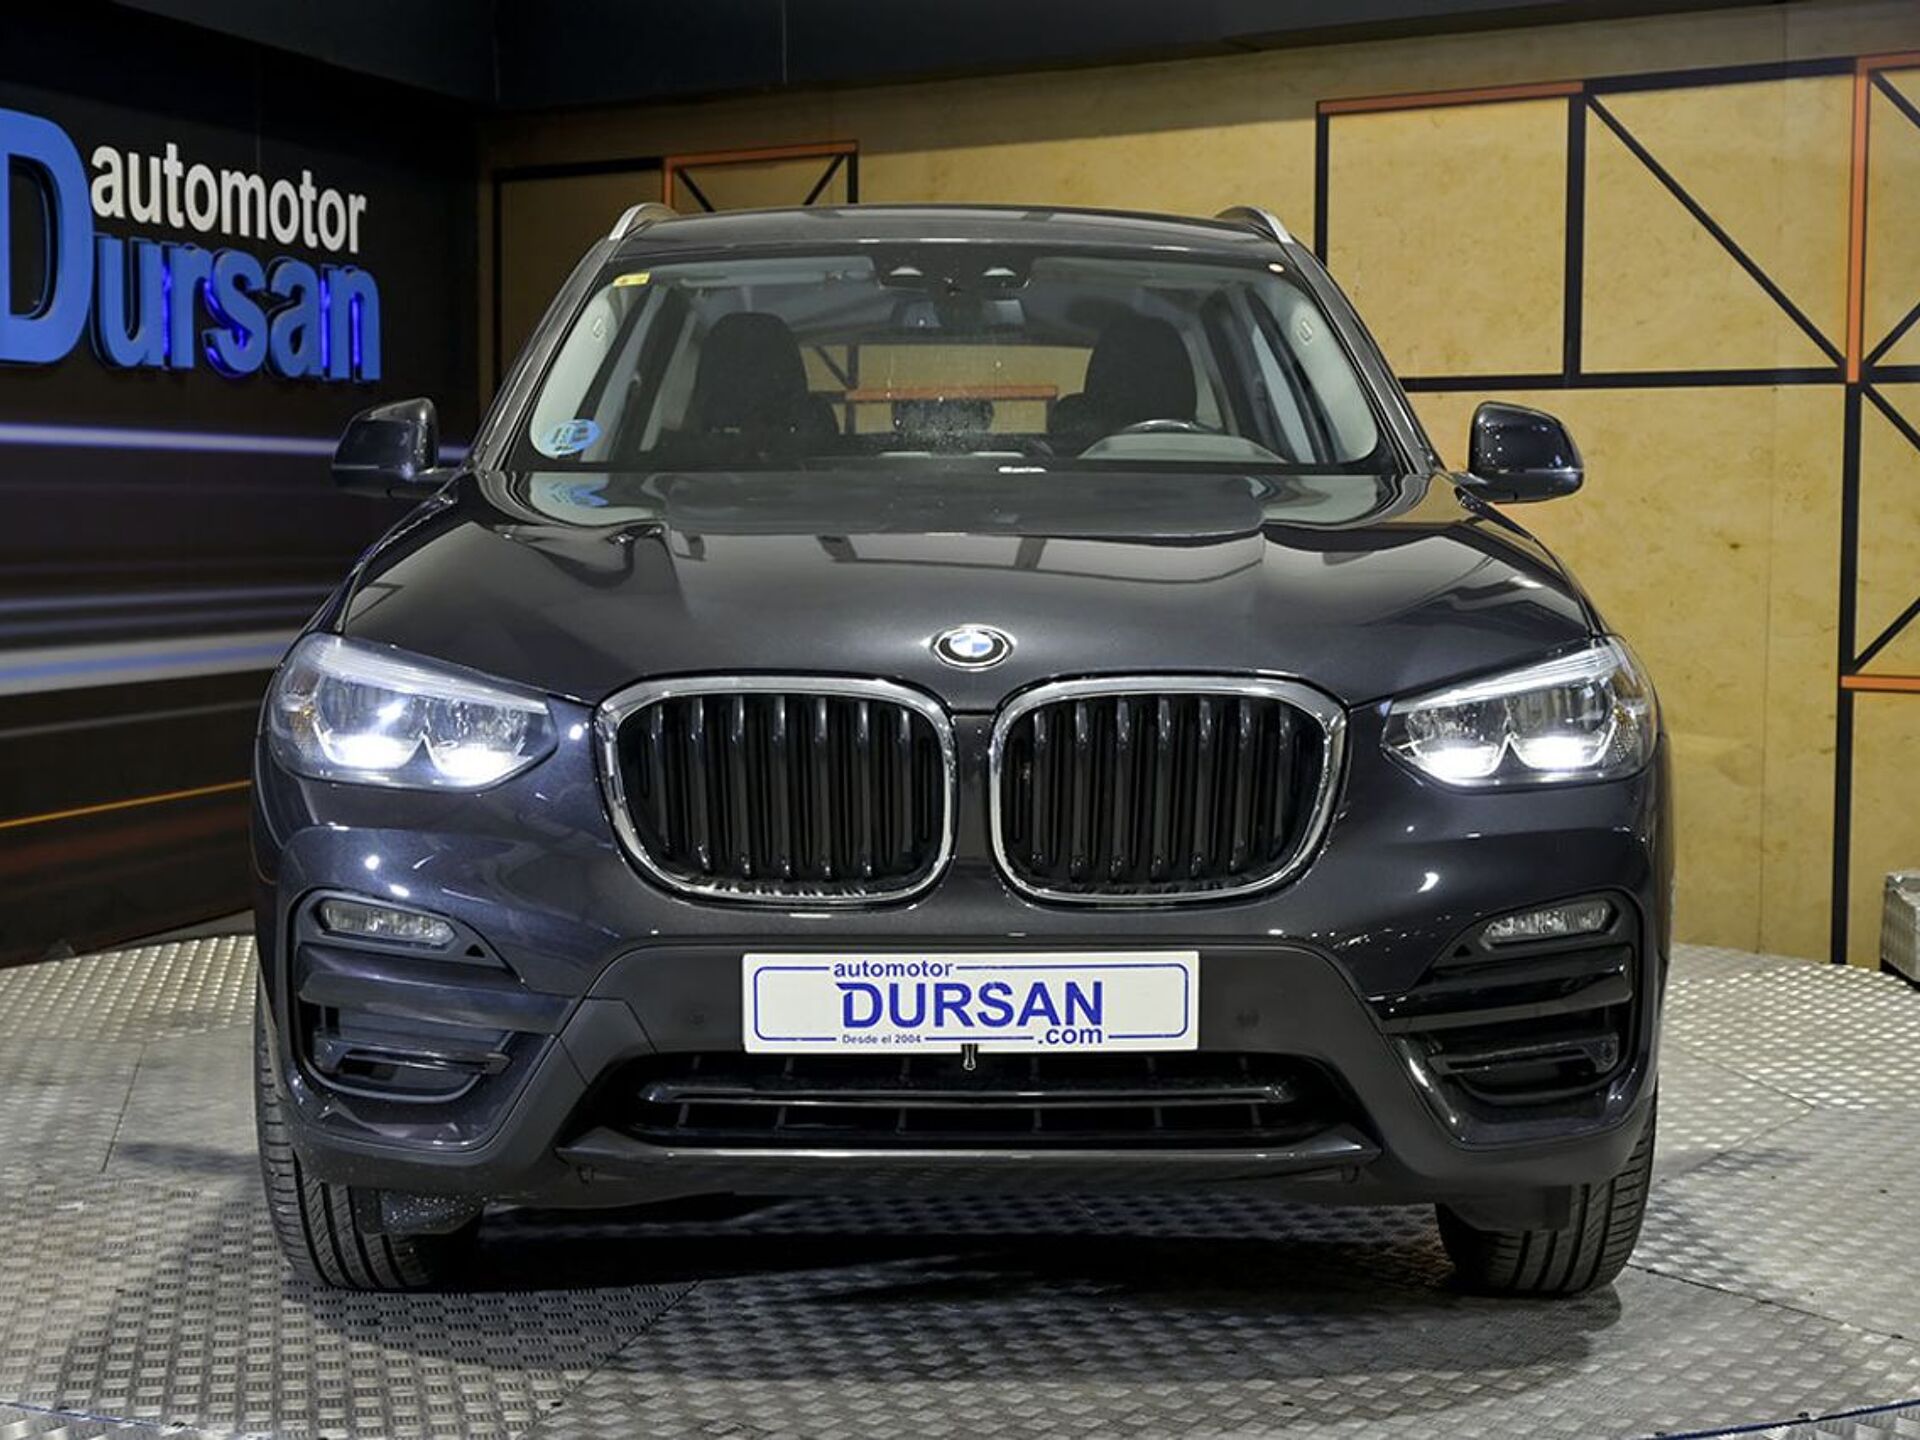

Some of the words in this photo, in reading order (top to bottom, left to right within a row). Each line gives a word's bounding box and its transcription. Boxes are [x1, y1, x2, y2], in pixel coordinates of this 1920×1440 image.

[91, 142, 366, 254] automotor
[0, 108, 381, 383] Dursan
[834, 960, 953, 977] automotor
[836, 981, 1102, 1028] DURSAN
[842, 1034, 878, 1044] Desde
[881, 1034, 891, 1043] el
[895, 1034, 921, 1044] 2004
[1038, 1028, 1102, 1044] .com
